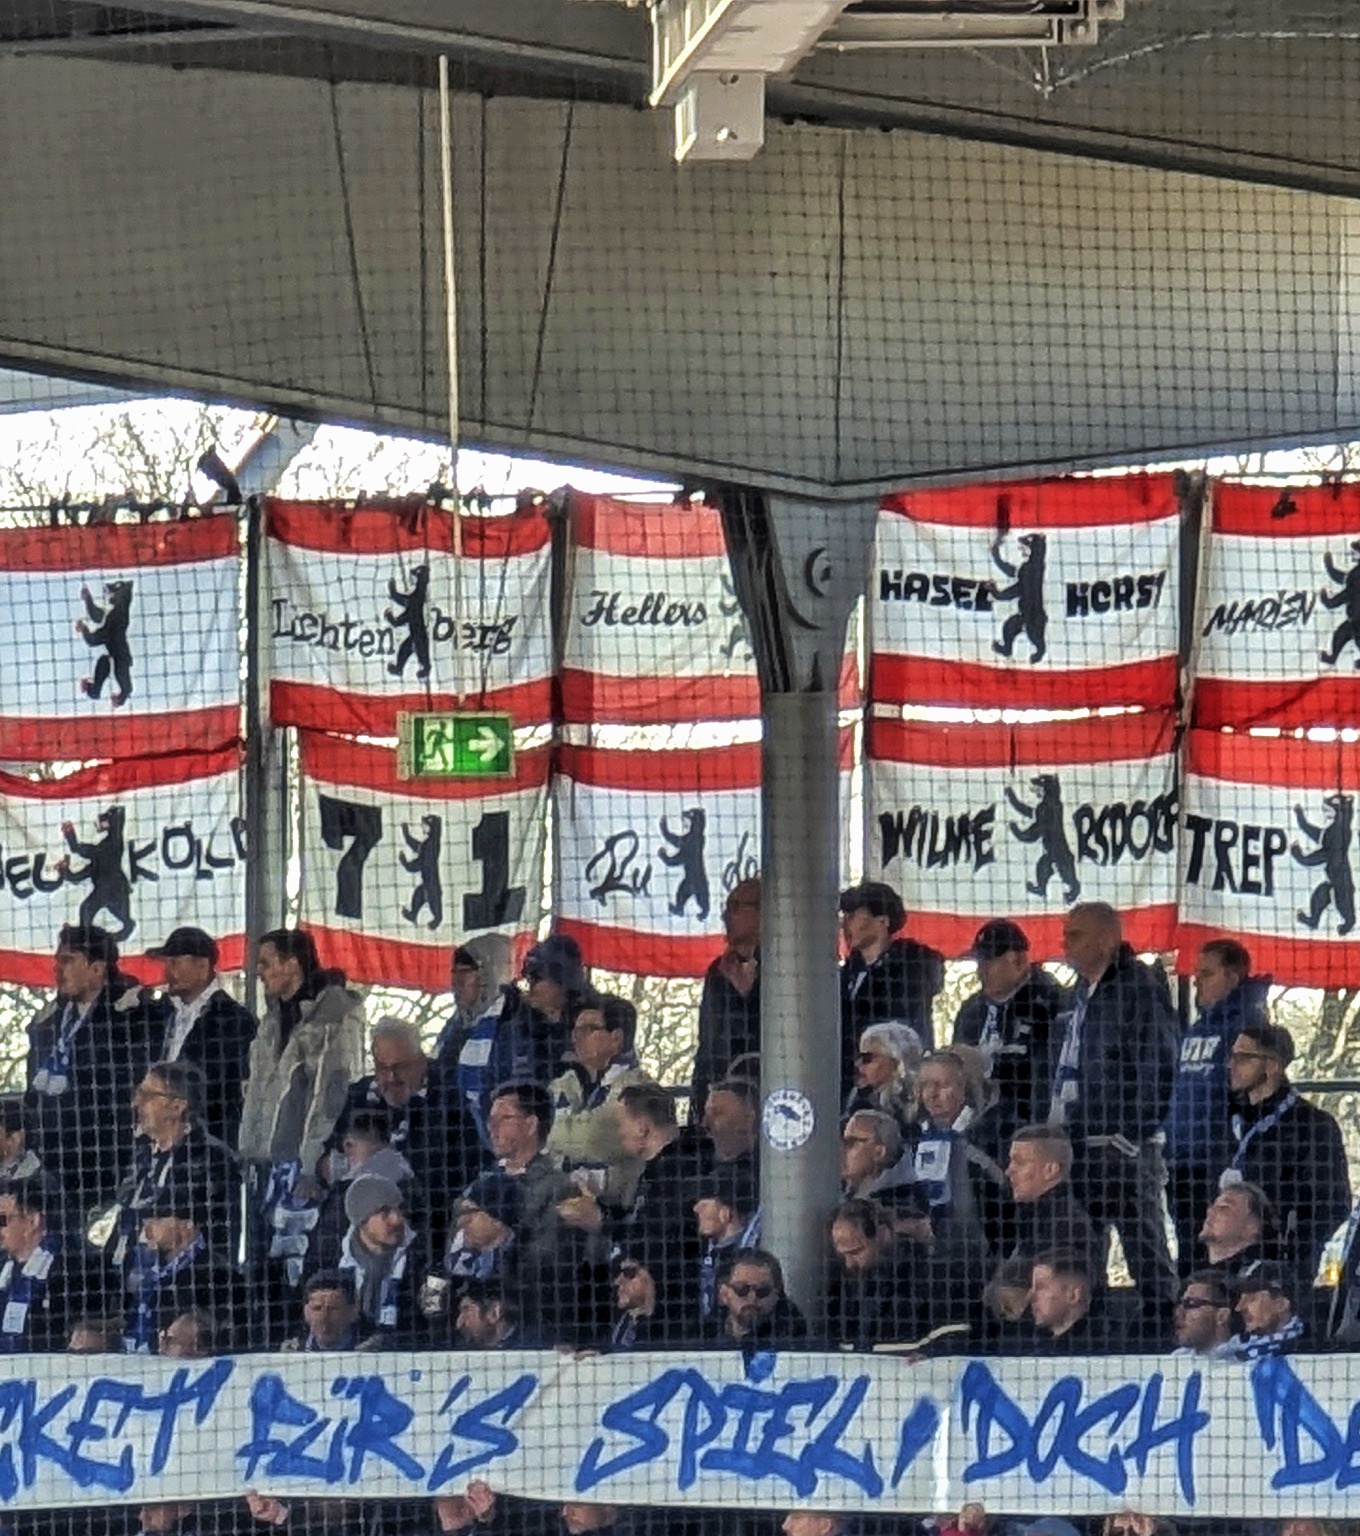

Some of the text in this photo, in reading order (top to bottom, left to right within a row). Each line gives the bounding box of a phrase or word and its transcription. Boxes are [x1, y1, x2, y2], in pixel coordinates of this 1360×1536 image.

[581, 590, 708, 628] Hellers
[880, 569, 996, 612] HASEL
[271, 597, 519, 659] Lichten berg
[319, 796, 526, 931] 7 1
[878, 804, 997, 873] WILME
[1185, 816, 1289, 897] TREP
[959, 1359, 1210, 1505] DOCH
